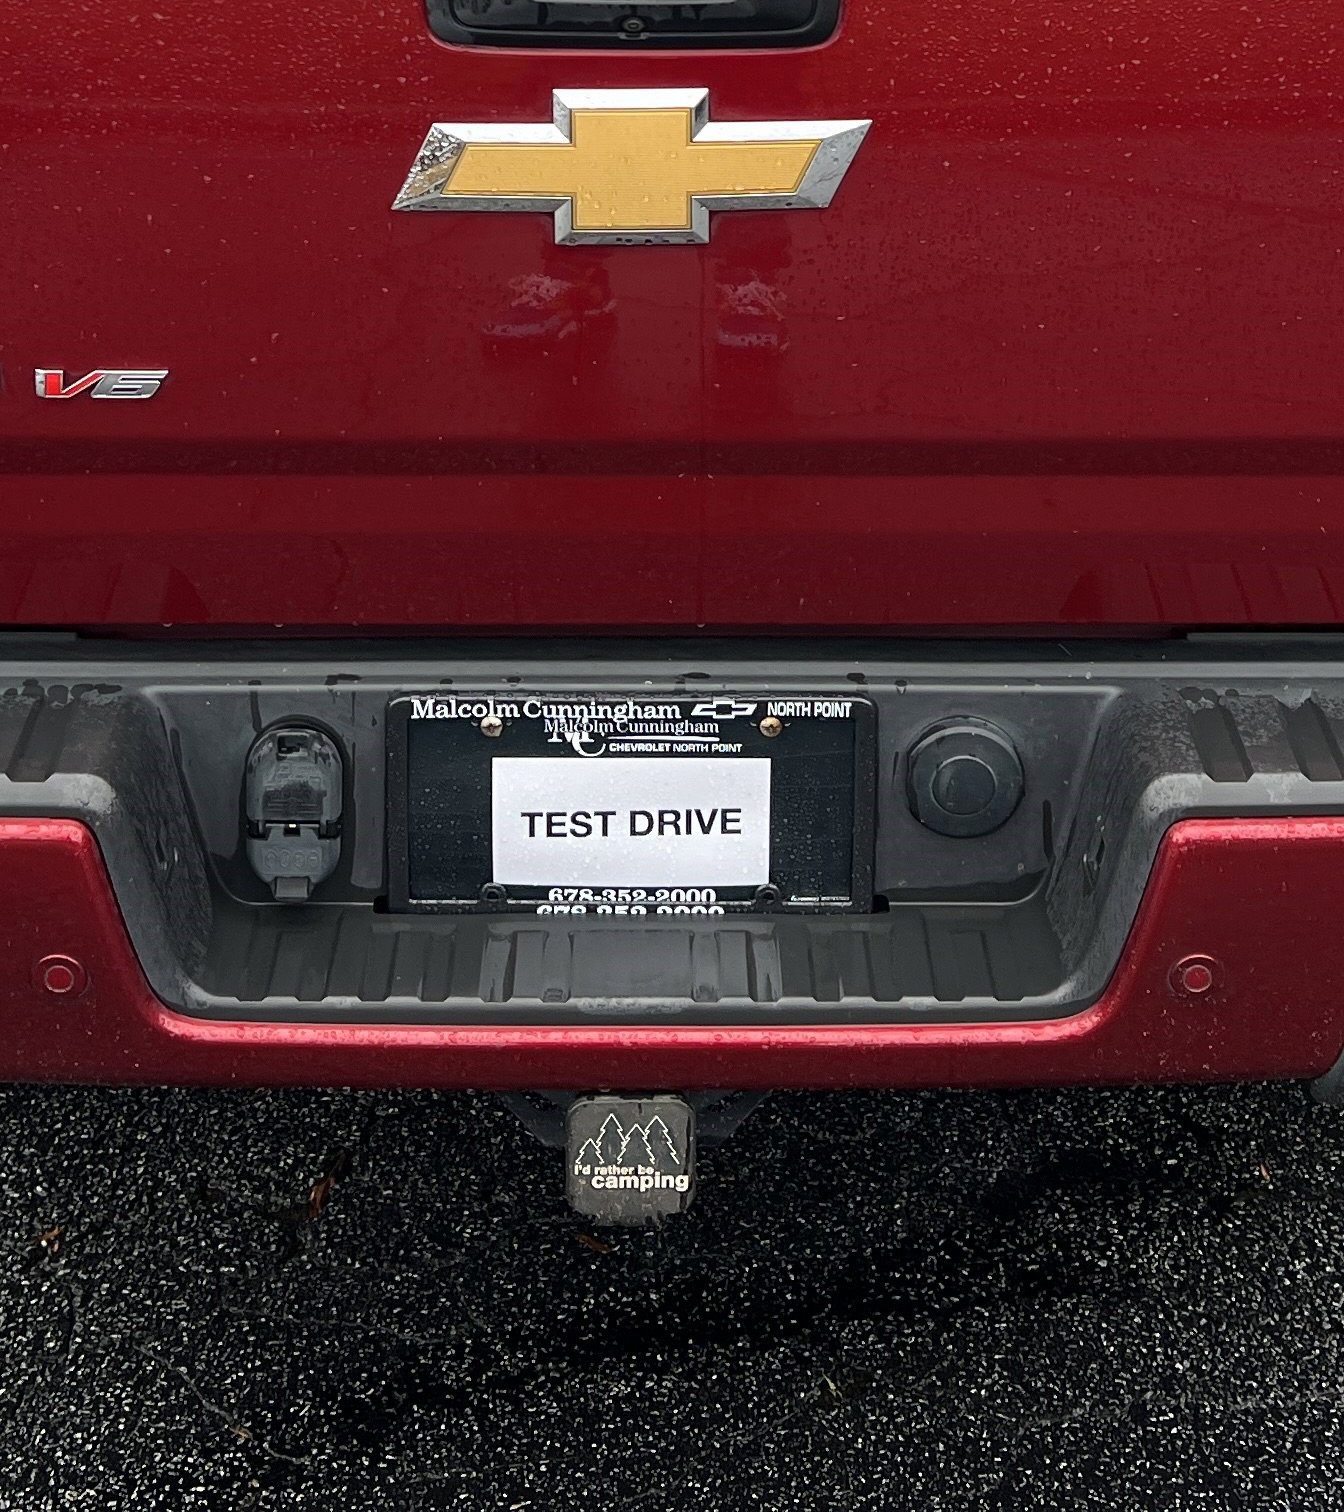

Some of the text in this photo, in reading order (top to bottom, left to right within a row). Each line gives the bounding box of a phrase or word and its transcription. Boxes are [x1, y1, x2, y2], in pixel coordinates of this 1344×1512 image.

[33, 368, 170, 400] V6
[411, 697, 853, 723] Malcolm Cunningham NORTH POINT
[544, 719, 720, 736] Malcolm Cunningham
[609, 742, 743, 753] CHEVROLET NORTH POINT
[520, 807, 743, 839] TEST DRIVE
[548, 888, 717, 902] 678-352-2000
[574, 1163, 655, 1176] I'd rather be
[591, 1171, 690, 1192] camping
